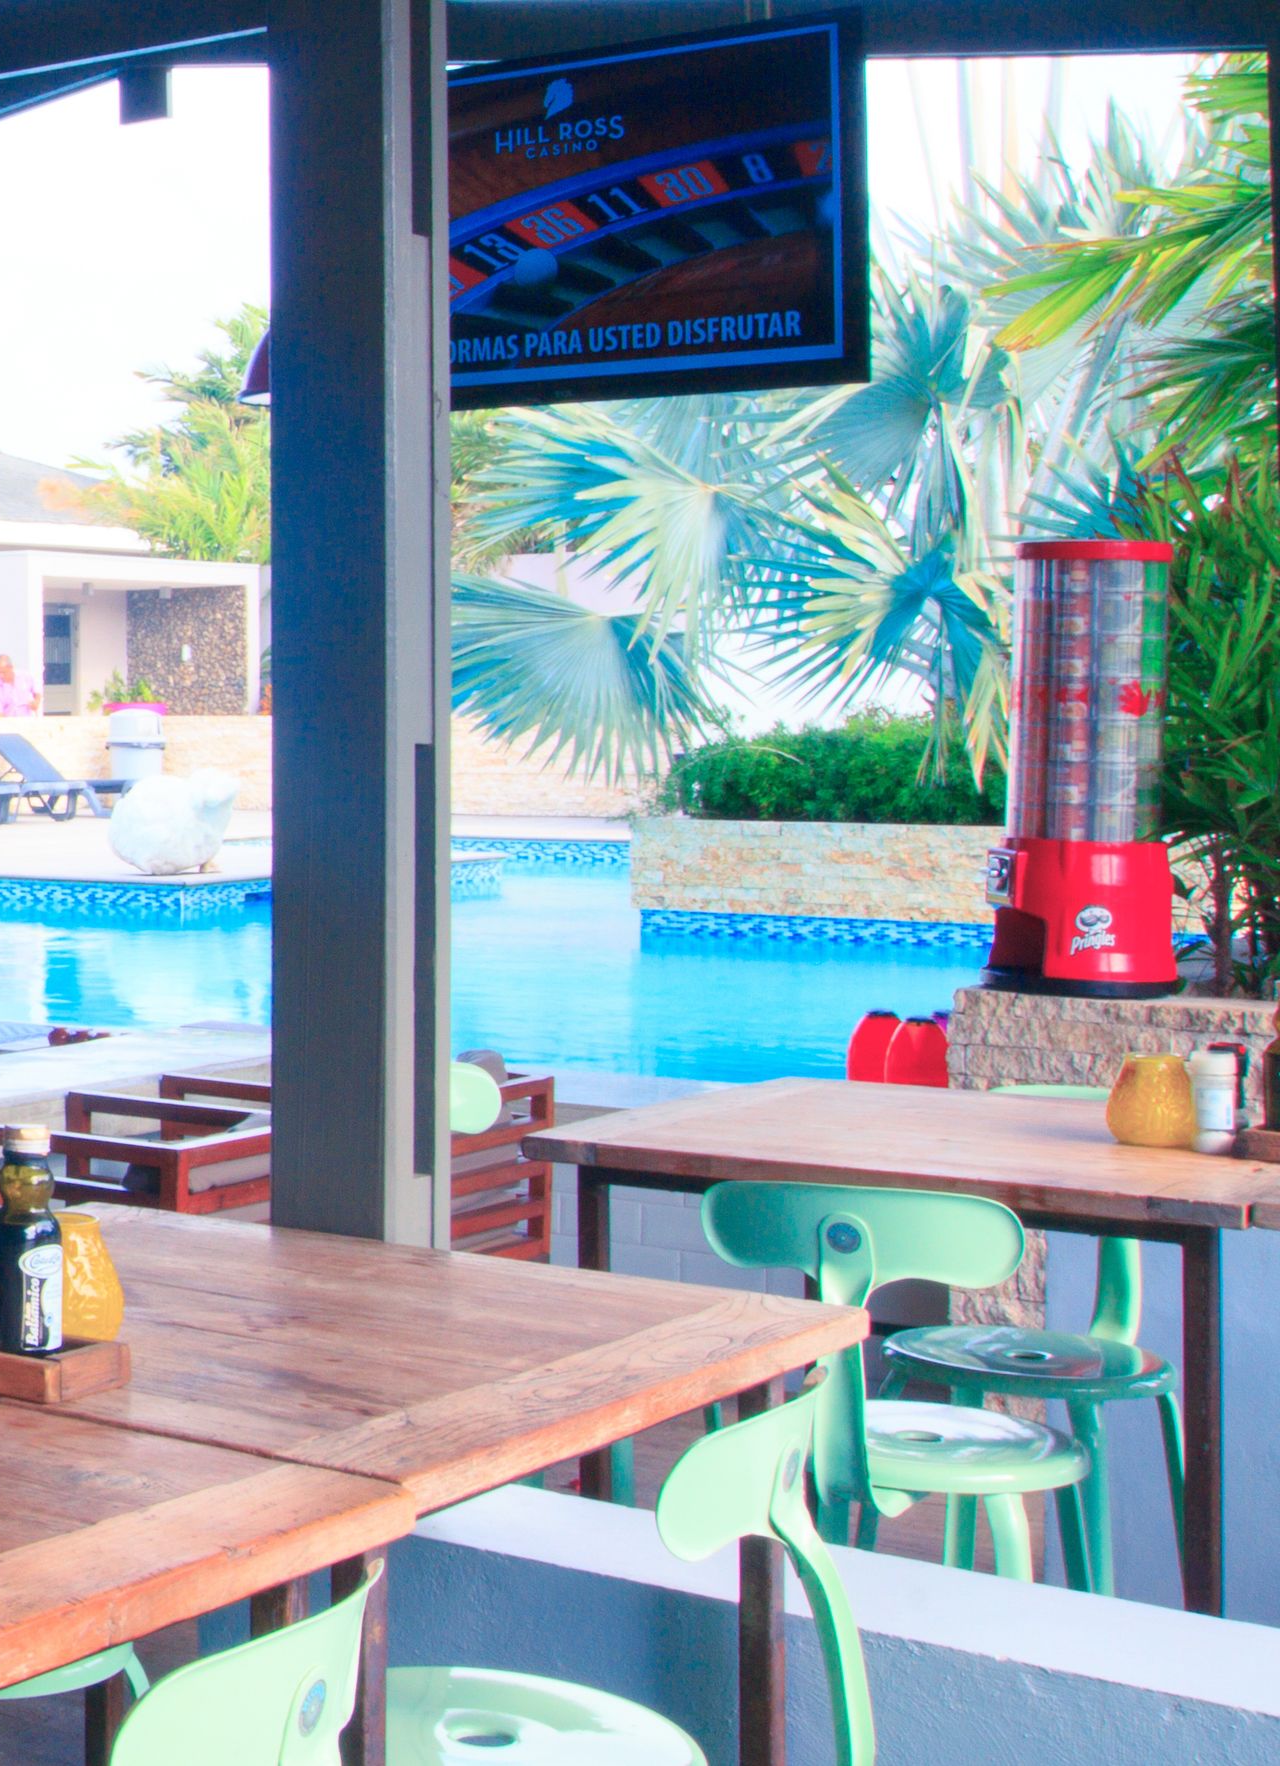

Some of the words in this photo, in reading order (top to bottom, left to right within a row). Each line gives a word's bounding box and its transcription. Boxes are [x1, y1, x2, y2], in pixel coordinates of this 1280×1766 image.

[495, 125, 551, 154] HILL
[559, 115, 625, 140] ROSS
[525, 139, 598, 159] CASINO
[521, 208, 584, 244] 36
[588, 187, 649, 222] 11
[655, 167, 714, 201] 30
[743, 153, 774, 183] 8
[525, 328, 583, 358] PARA
[589, 322, 662, 352] USTED
[667, 310, 801, 346] DISFRUTAR
[1069, 930, 1116, 957] Pringles
